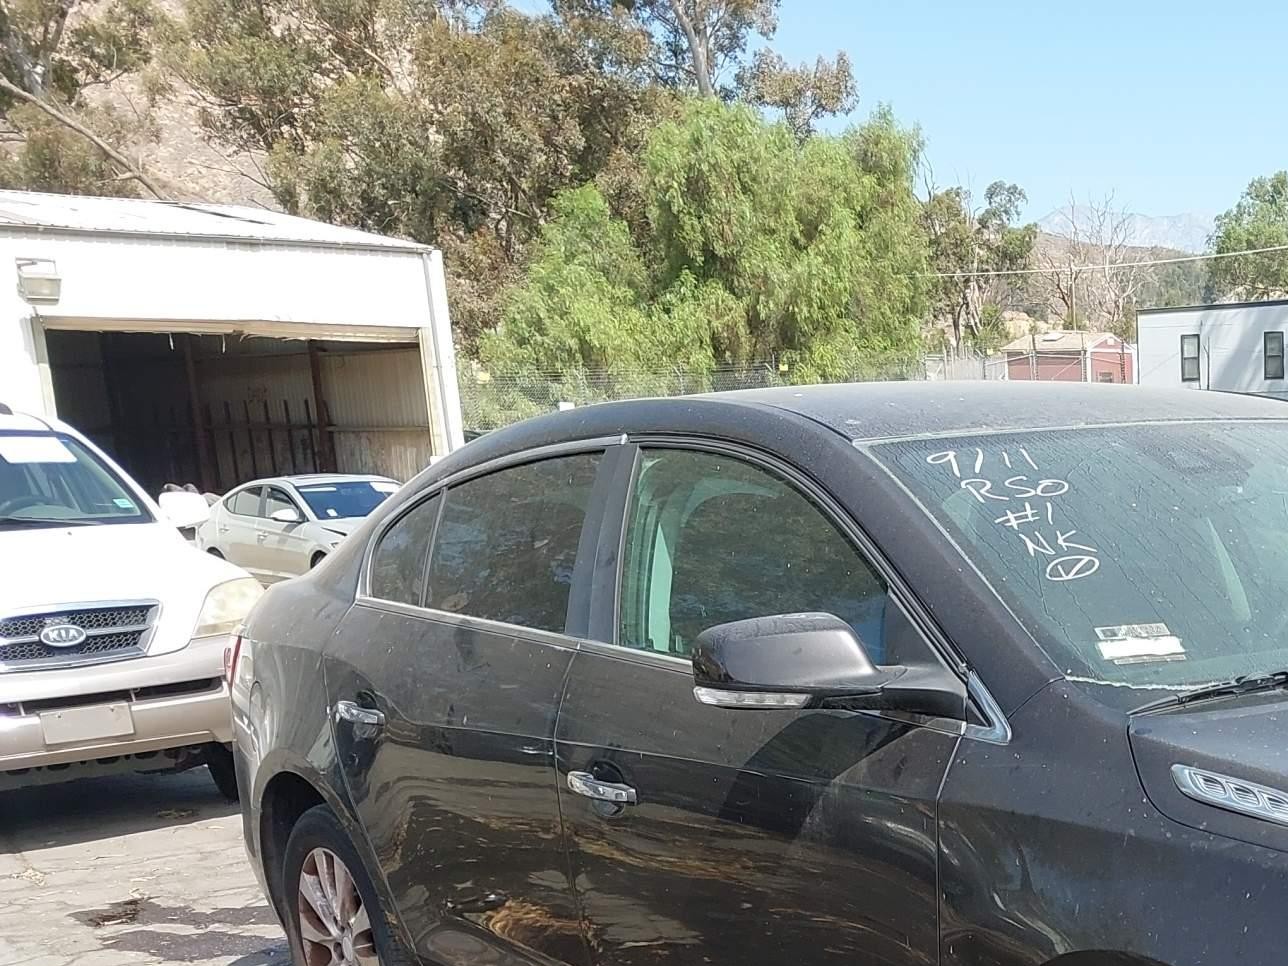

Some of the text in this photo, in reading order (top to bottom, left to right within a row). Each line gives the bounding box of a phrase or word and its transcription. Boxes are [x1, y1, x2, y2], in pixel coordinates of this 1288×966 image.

[960, 475, 1069, 503] RSO
[994, 502, 1054, 530] #1
[1018, 530, 1098, 557] NK
[48, 628, 79, 642] KIA
